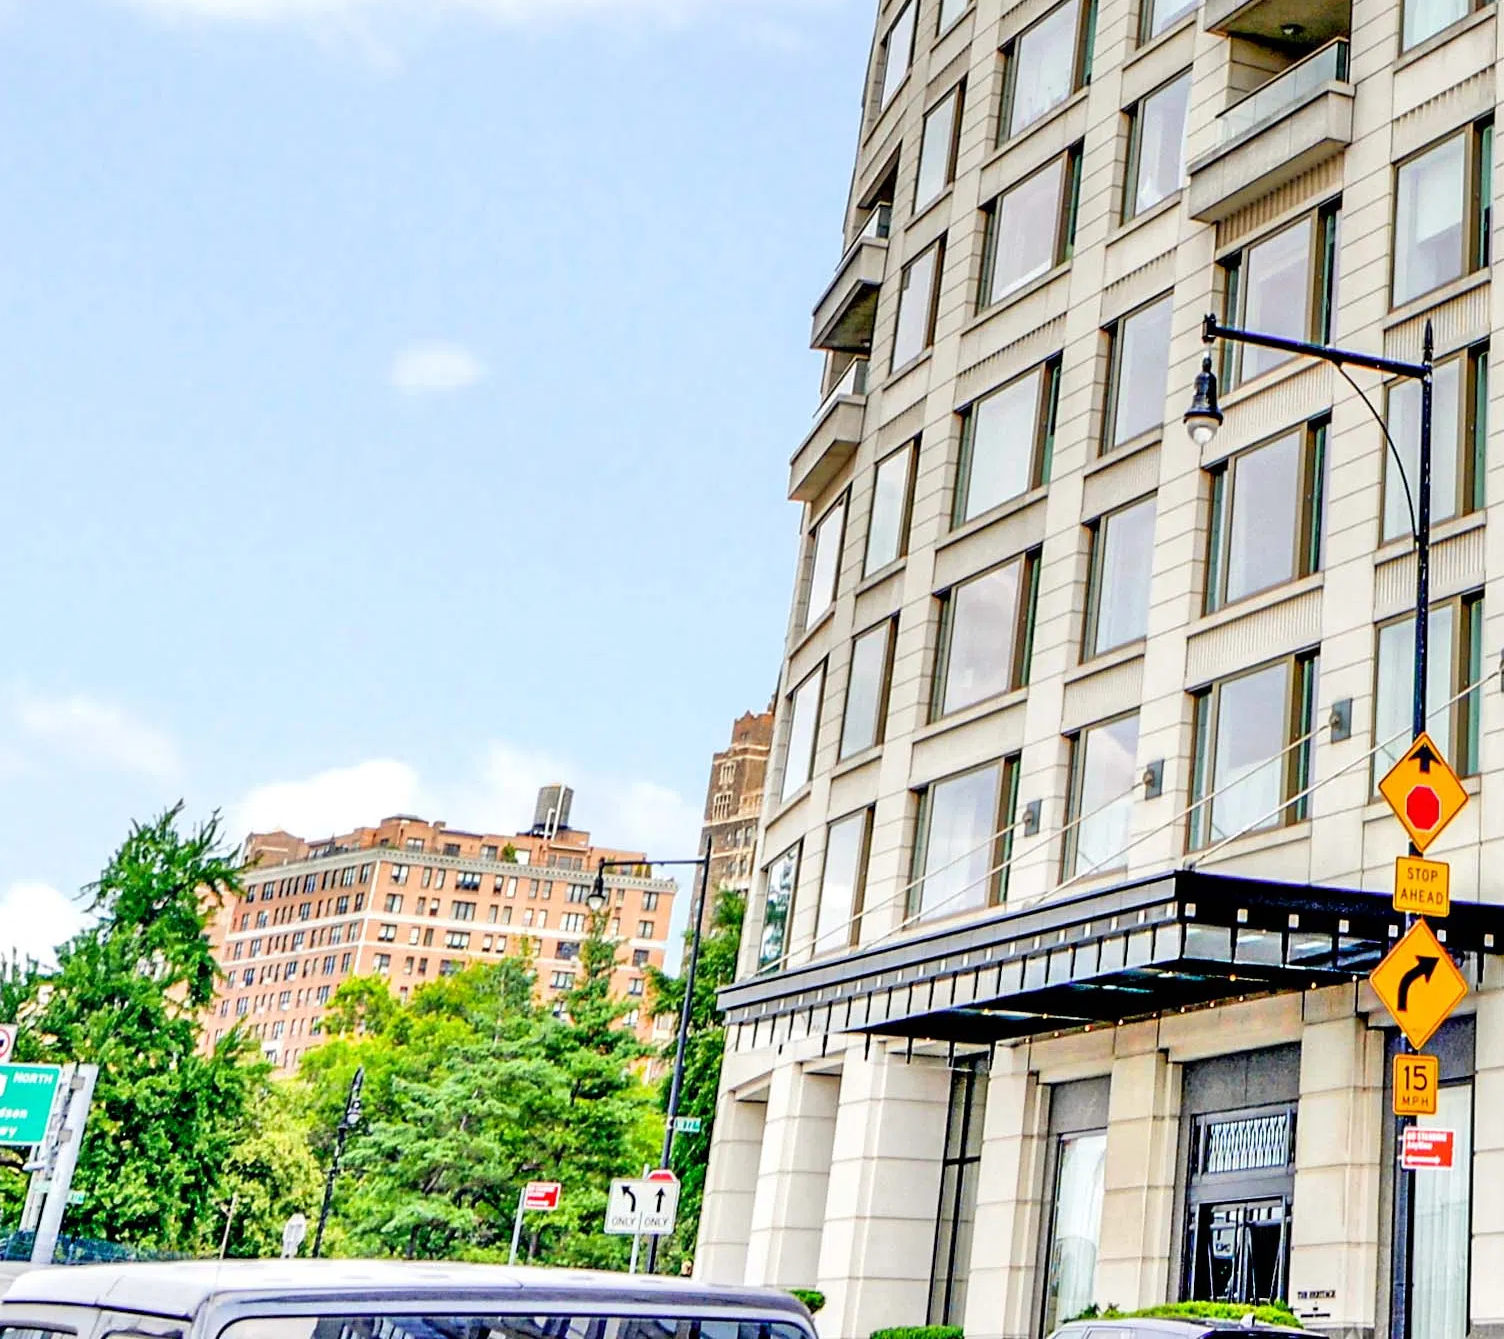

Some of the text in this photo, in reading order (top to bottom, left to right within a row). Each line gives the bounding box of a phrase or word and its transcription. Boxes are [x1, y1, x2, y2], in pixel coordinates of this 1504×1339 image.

[1407, 866, 1438, 883] STOP
[1400, 887, 1444, 905] AHEAD
[12, 1072, 54, 1084] NORTH
[1404, 1065, 1428, 1091] 15
[611, 1216, 637, 1228] ONLY
[644, 1216, 670, 1228] ONLY
